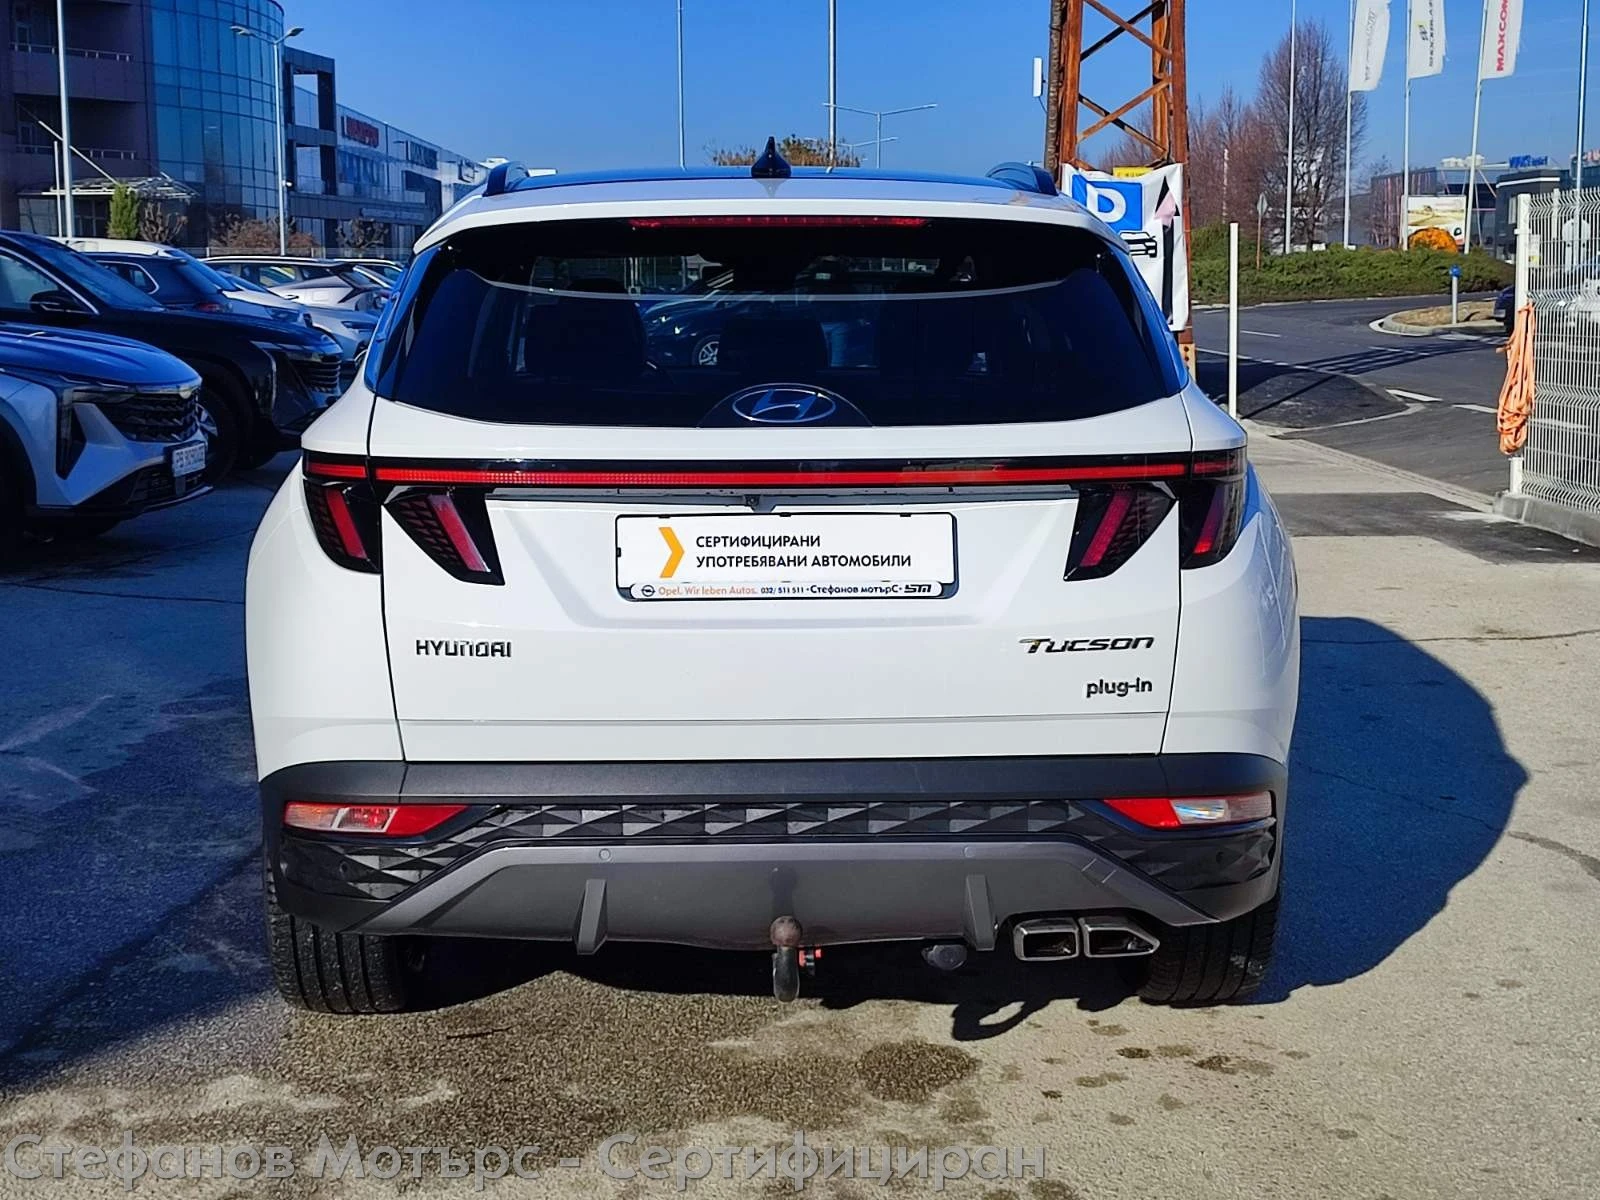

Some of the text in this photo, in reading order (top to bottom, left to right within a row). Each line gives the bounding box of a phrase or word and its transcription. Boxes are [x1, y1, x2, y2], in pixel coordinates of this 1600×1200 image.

[696, 535, 821, 550] СЕРТИФИЦИРАНИ
[696, 555, 911, 568] УПОТРЕБЯВАНИ АВТОМОБИЛИ
[658, 586, 682, 596] Opel.
[685, 586, 700, 594] Wir
[701, 586, 727, 594] leben
[416, 639, 511, 657] HYUNDAI
[1086, 677, 1153, 698] plug-in
